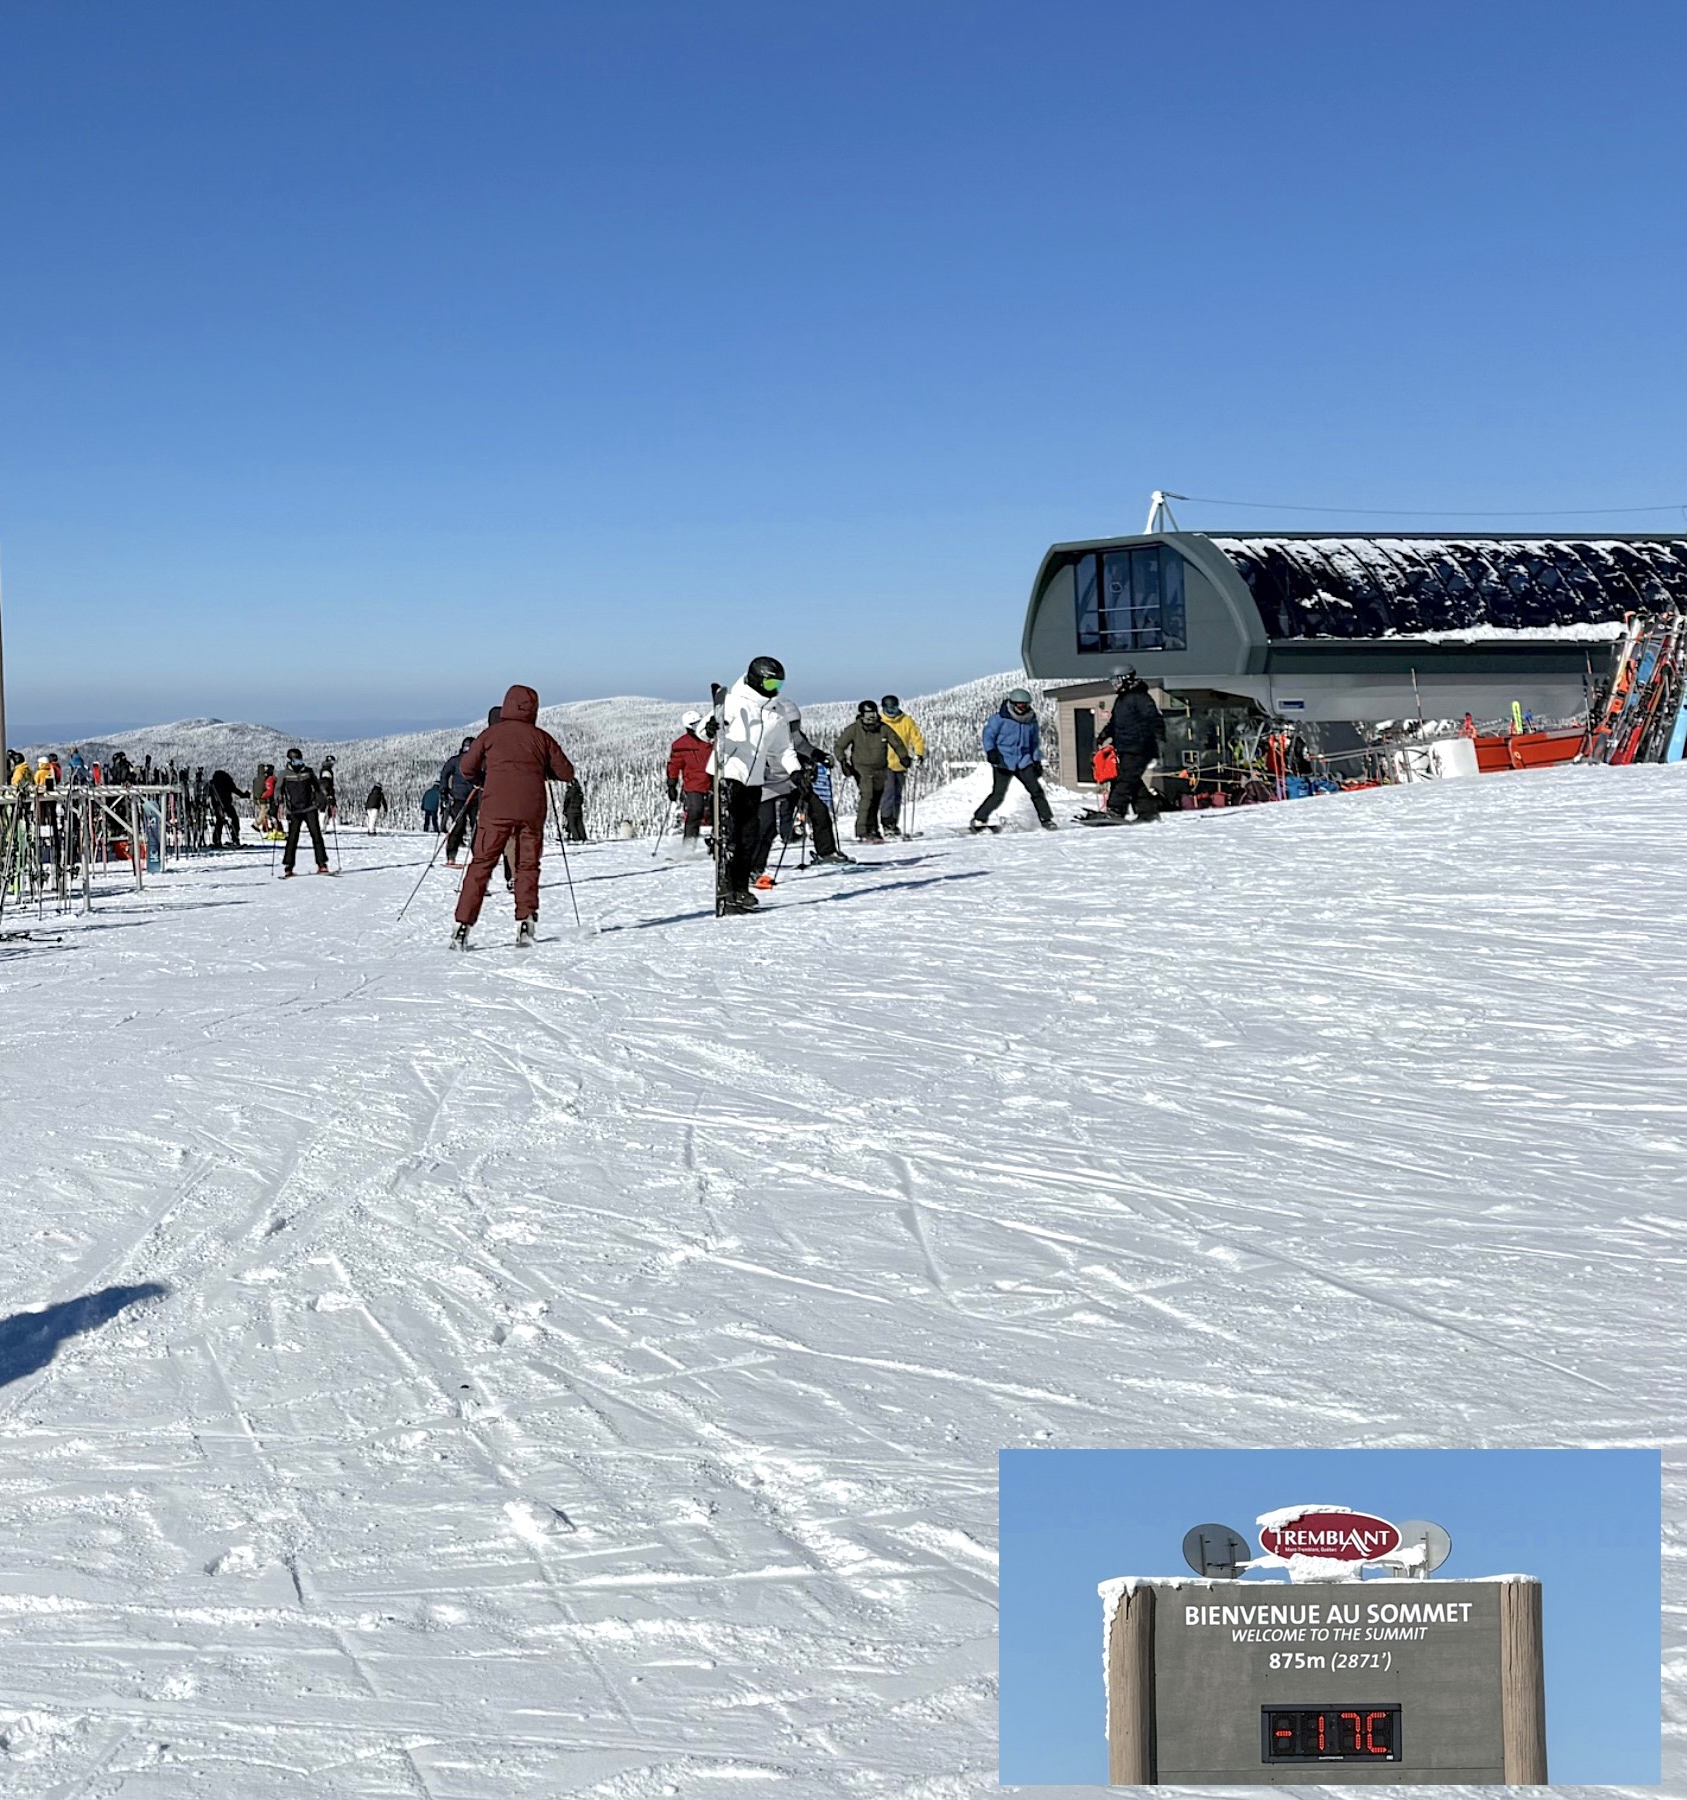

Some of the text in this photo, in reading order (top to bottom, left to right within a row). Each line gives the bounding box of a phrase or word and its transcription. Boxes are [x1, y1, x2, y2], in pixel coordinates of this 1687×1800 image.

[1277, 1528, 1391, 1556] TREMBLANT
[1185, 1602, 1473, 1626] BIENVENUE AU SOMMET
[1232, 1627, 1428, 1642] WELCOME TO THE SUMMIT
[1269, 1652, 1325, 1669] 875m
